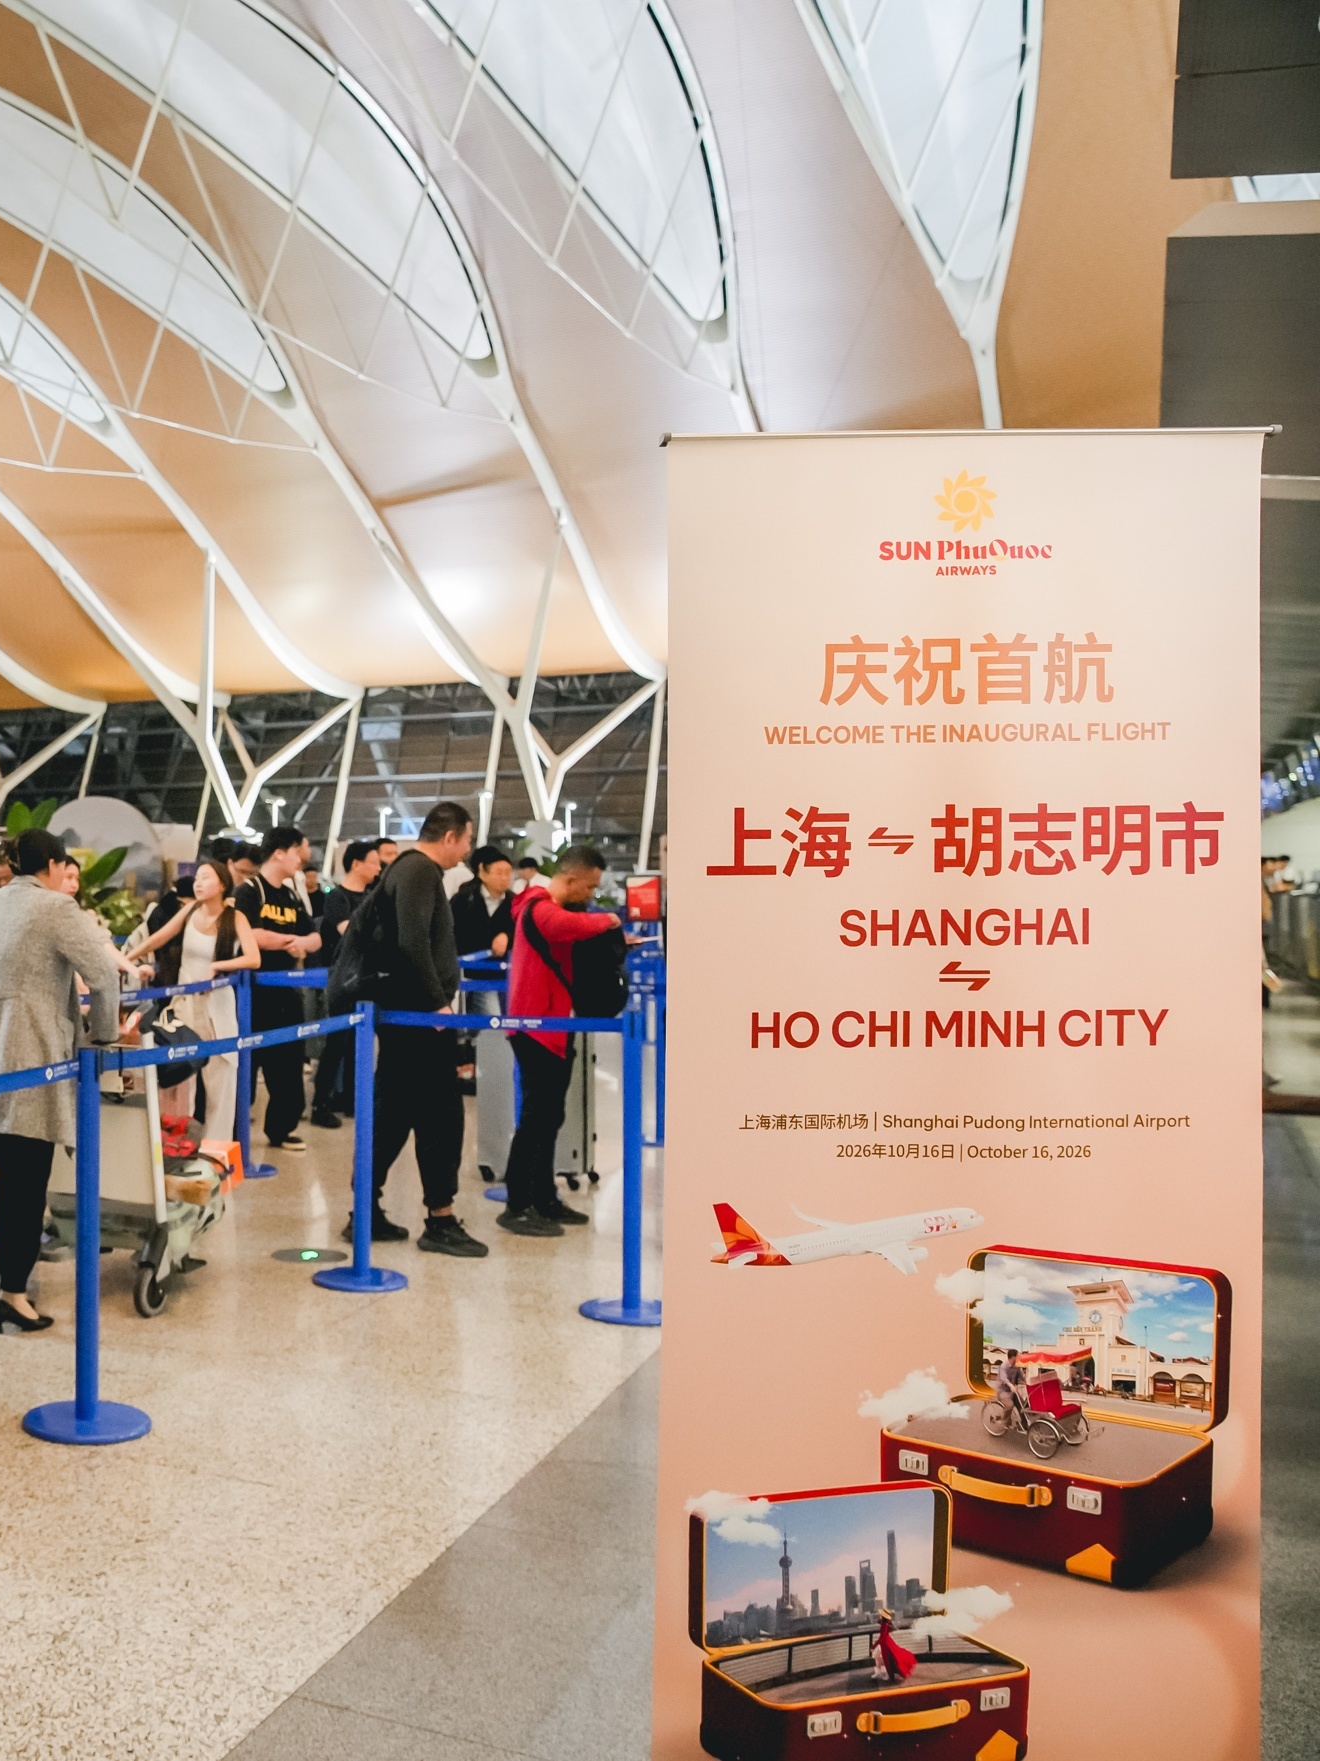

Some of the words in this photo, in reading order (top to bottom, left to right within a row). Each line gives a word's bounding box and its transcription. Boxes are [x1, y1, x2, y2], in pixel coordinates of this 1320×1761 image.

[879, 540, 932, 561] SUN
[935, 565, 997, 577] AIRWAYS
[819, 632, 1114, 707] 庆祝首航
[764, 725, 885, 745] WELCOME
[890, 724, 936, 744] THE
[942, 723, 1081, 743] INAUGURAL
[1087, 722, 1171, 741] FLIGHT
[706, 806, 852, 878] 上海
[930, 801, 1225, 878] 胡志明市
[839, 907, 1090, 948] SHANGHAI
[750, 1011, 819, 1049] HO
[831, 1010, 911, 1049] CHI
[925, 1010, 1045, 1048] MINH
[1058, 1008, 1169, 1048] CITY
[738, 1113, 869, 1131] 上海浦东国际机场
[882, 1114, 959, 1132] Shanghai
[963, 1115, 1025, 1133] Pudong
[1029, 1113, 1129, 1129] International
[1133, 1113, 1190, 1131] Airport
[836, 1143, 955, 1160] 2026年10月16日
[967, 1144, 1029, 1159] October
[1032, 1145, 1053, 1161] 16,
[1056, 1144, 1091, 1159] 2026
